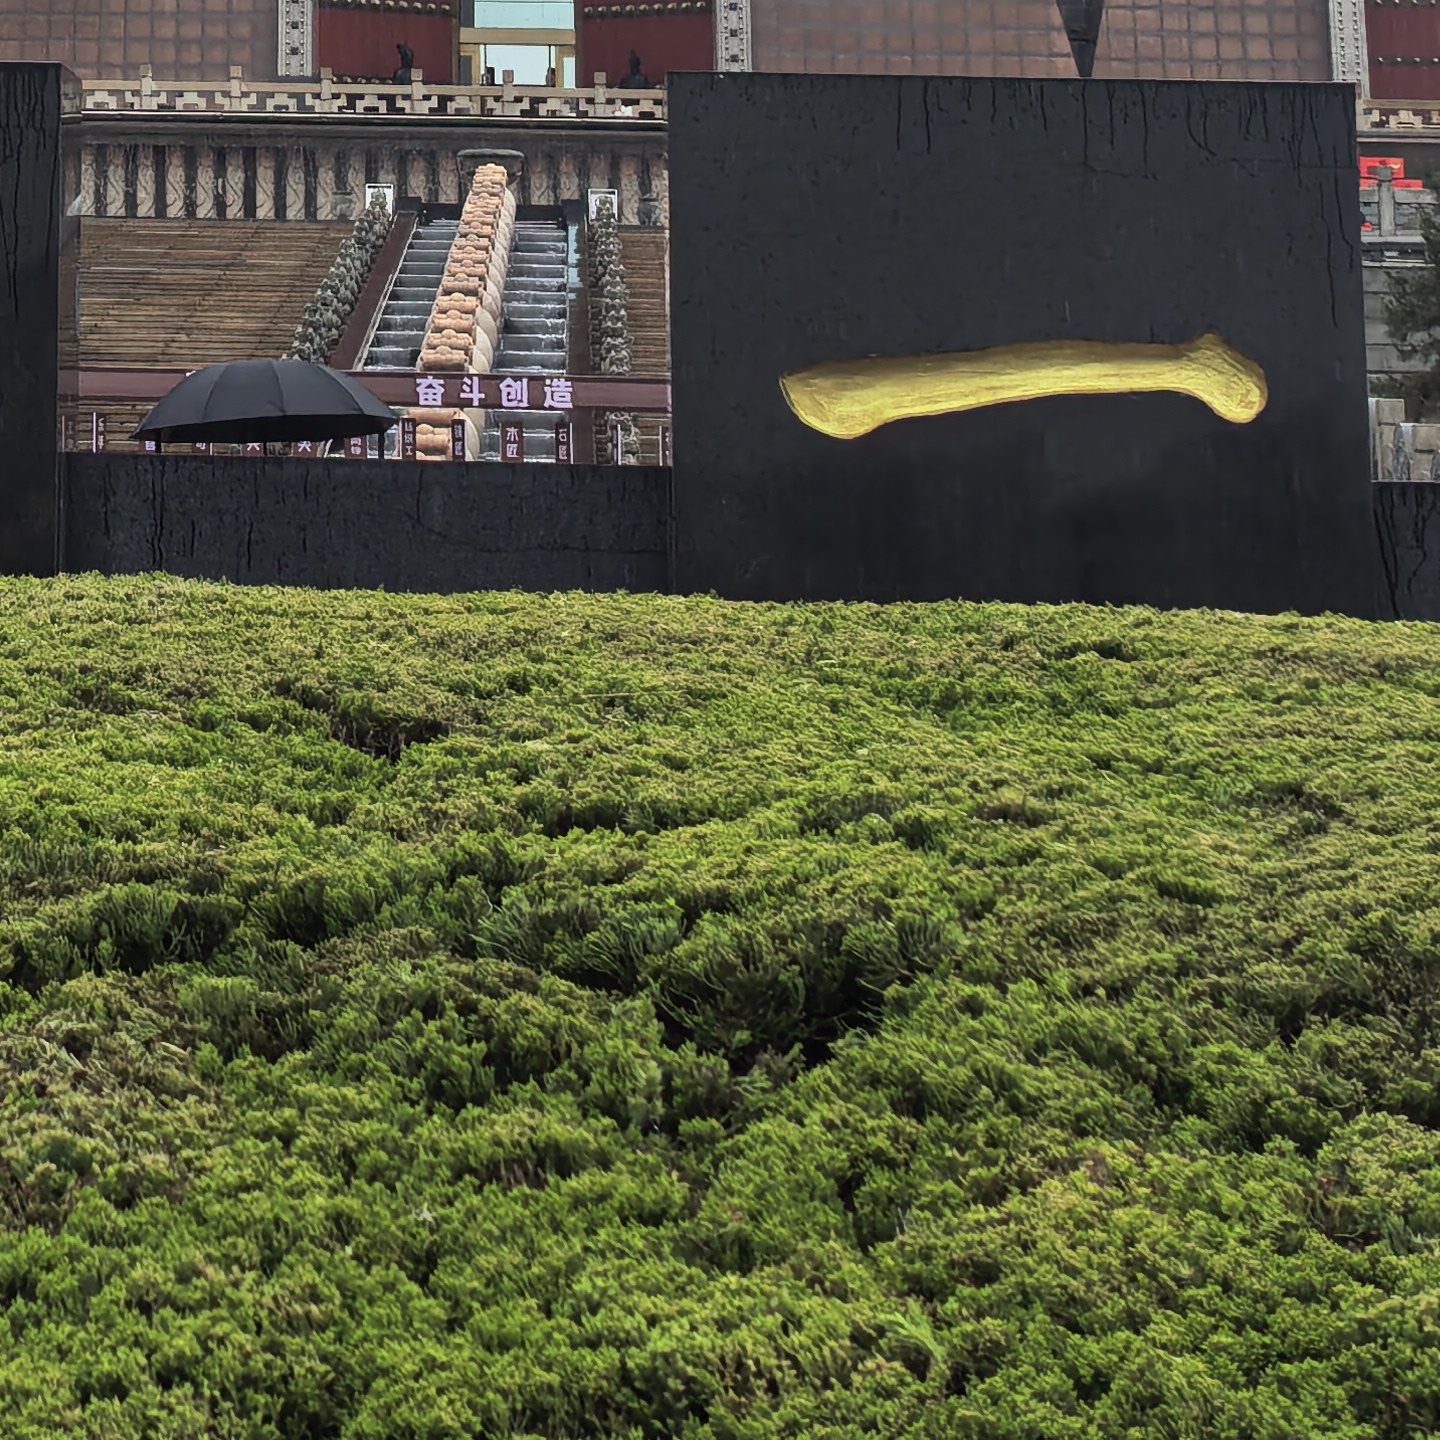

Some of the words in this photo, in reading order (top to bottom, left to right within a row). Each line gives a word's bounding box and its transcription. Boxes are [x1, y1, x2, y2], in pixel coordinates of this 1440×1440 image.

[415, 375, 574, 410] 奋斗创造
[778, 328, 1269, 439] 一
[506, 427, 519, 458] 木匠
